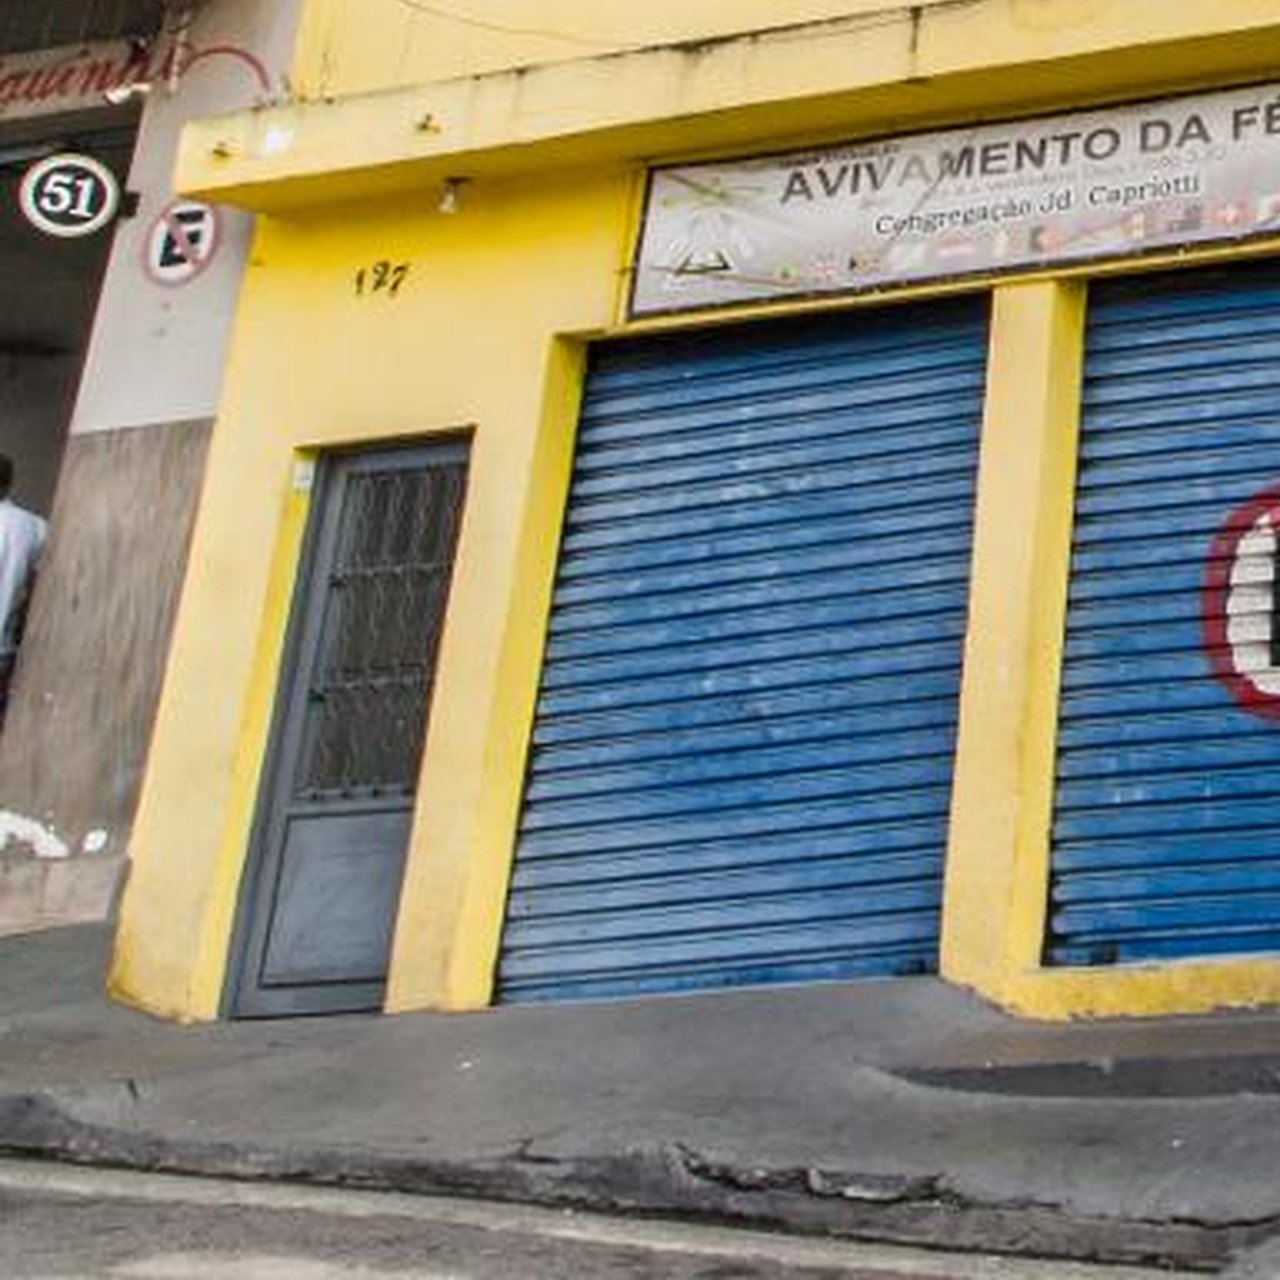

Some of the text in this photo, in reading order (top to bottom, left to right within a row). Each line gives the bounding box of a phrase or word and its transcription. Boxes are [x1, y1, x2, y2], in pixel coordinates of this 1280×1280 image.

[780, 126, 1121, 205] AVIVAMENTO
[1139, 114, 1211, 153] DA
[39, 173, 97, 219] 51
[875, 173, 1201, 237] Congregação Jd Capriotti
